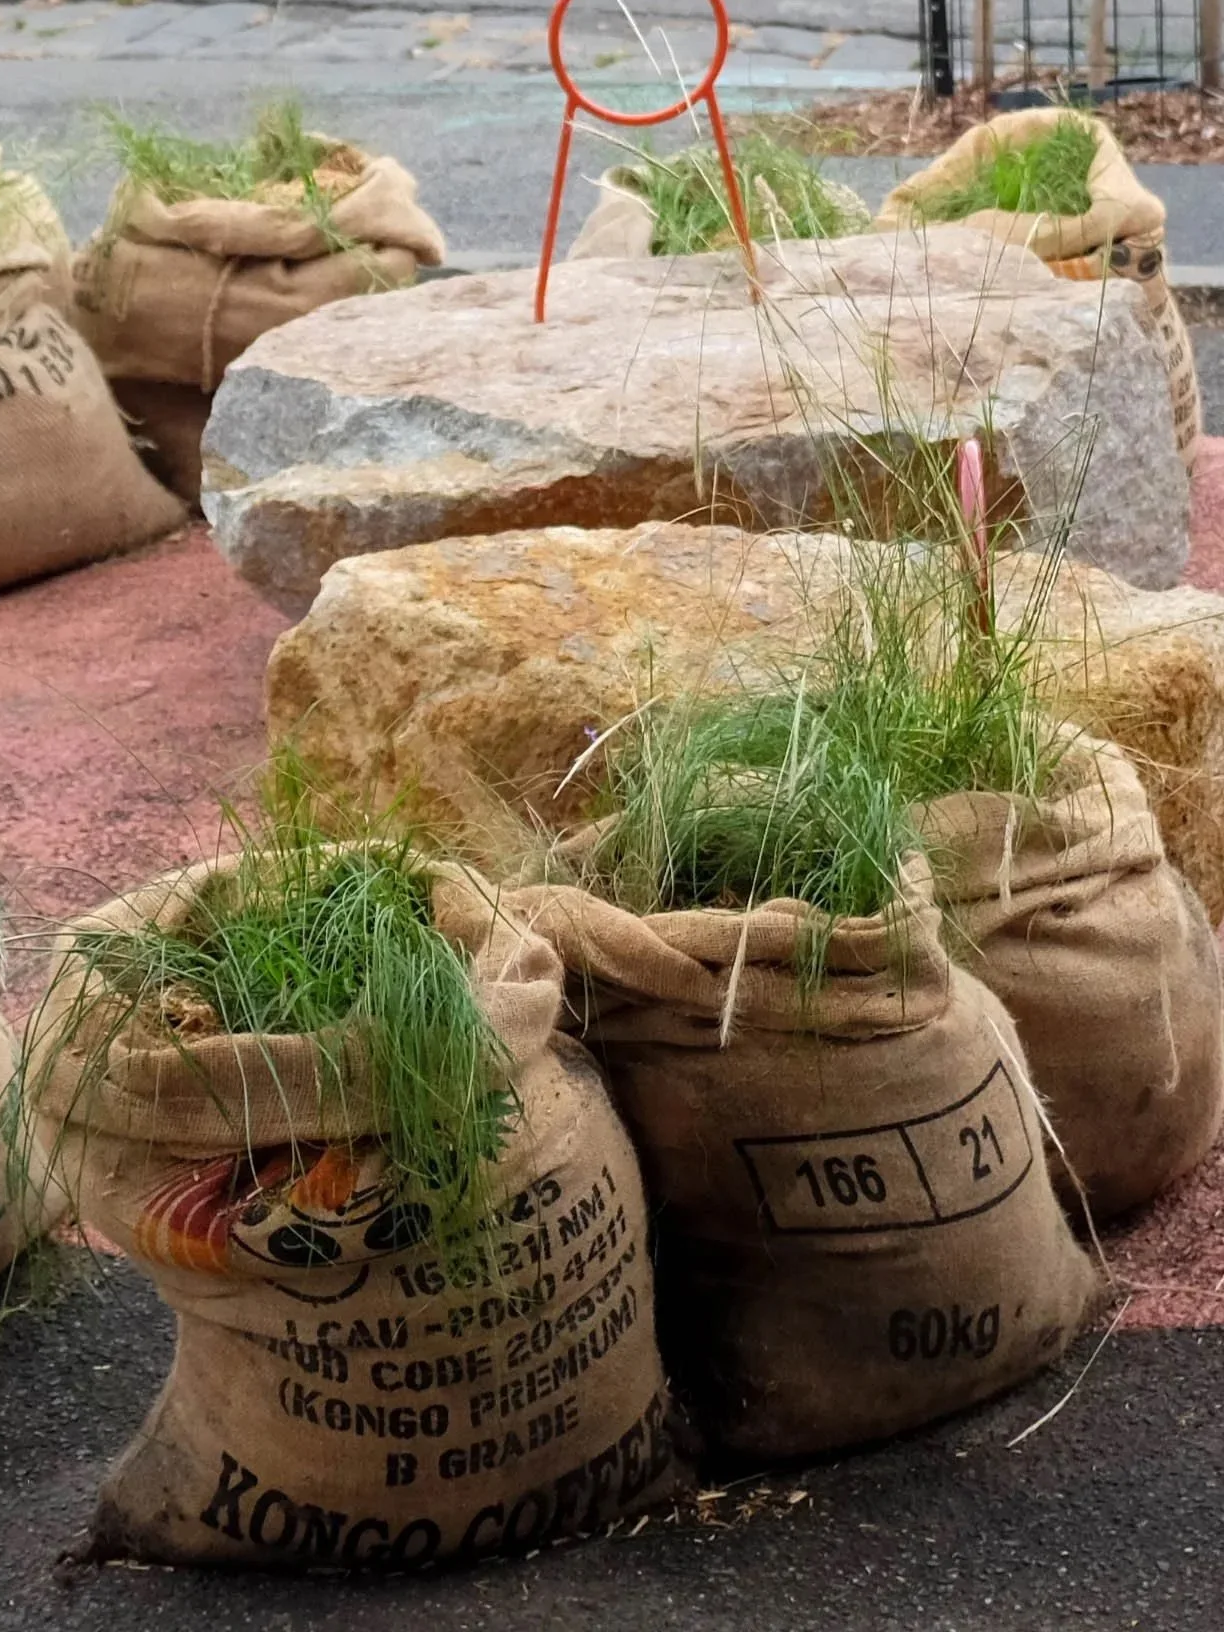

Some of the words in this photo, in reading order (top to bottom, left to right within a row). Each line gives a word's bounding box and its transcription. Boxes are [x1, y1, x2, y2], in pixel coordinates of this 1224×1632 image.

[795, 1153, 887, 1208] 166
[959, 1114, 1005, 1181] 21
[278, 1376, 450, 1440] (KONGO
[469, 1284, 638, 1429] PREMIUM)
[888, 1303, 1001, 1361] 60kg
[371, 1346, 493, 1393] CODE
[385, 1452, 419, 1488] B
[437, 1395, 580, 1481] GRADE
[200, 1449, 442, 1564] KONGO
[460, 1392, 673, 1560] COFFEE
